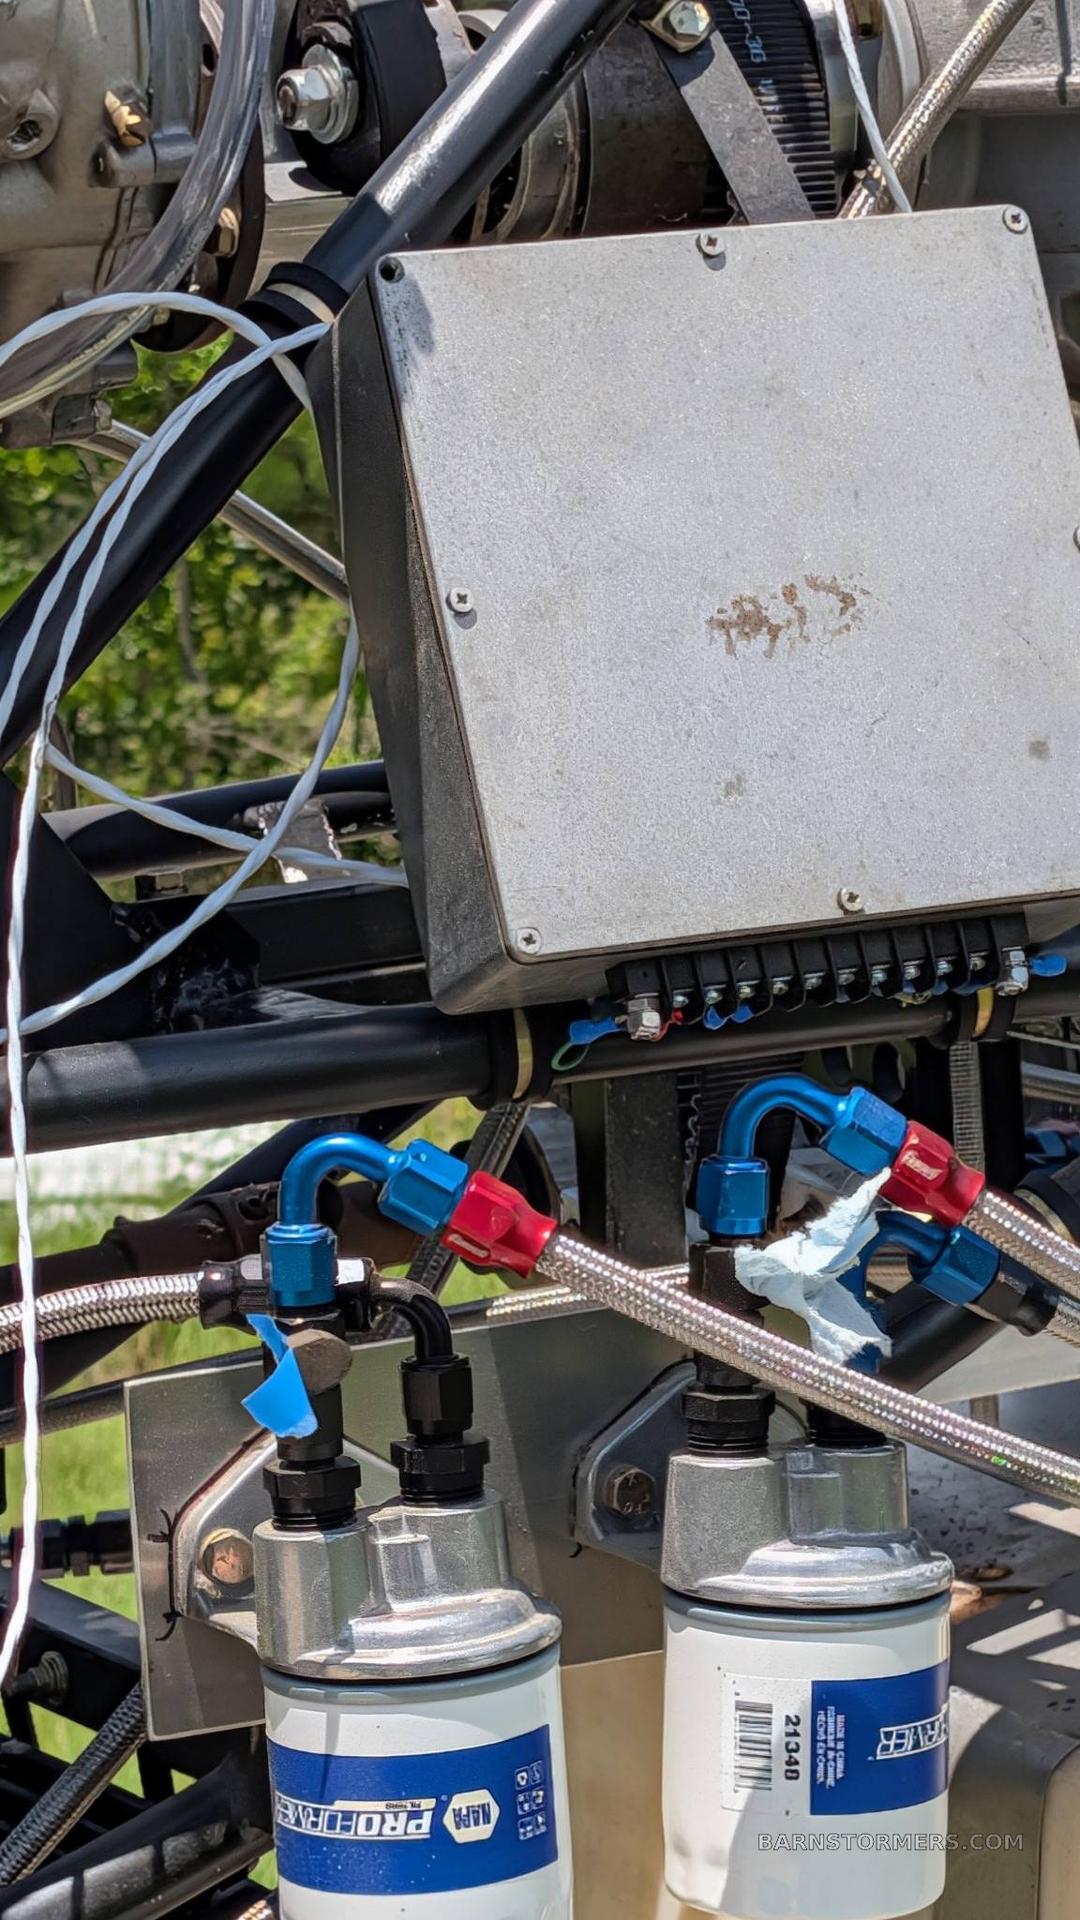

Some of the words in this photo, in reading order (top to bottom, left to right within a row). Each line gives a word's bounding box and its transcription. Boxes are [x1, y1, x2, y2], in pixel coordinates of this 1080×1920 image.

[784, 1714, 801, 1781] 21348
[274, 1799, 434, 1838] PROFORME
[453, 1802, 491, 1830] NAPA
